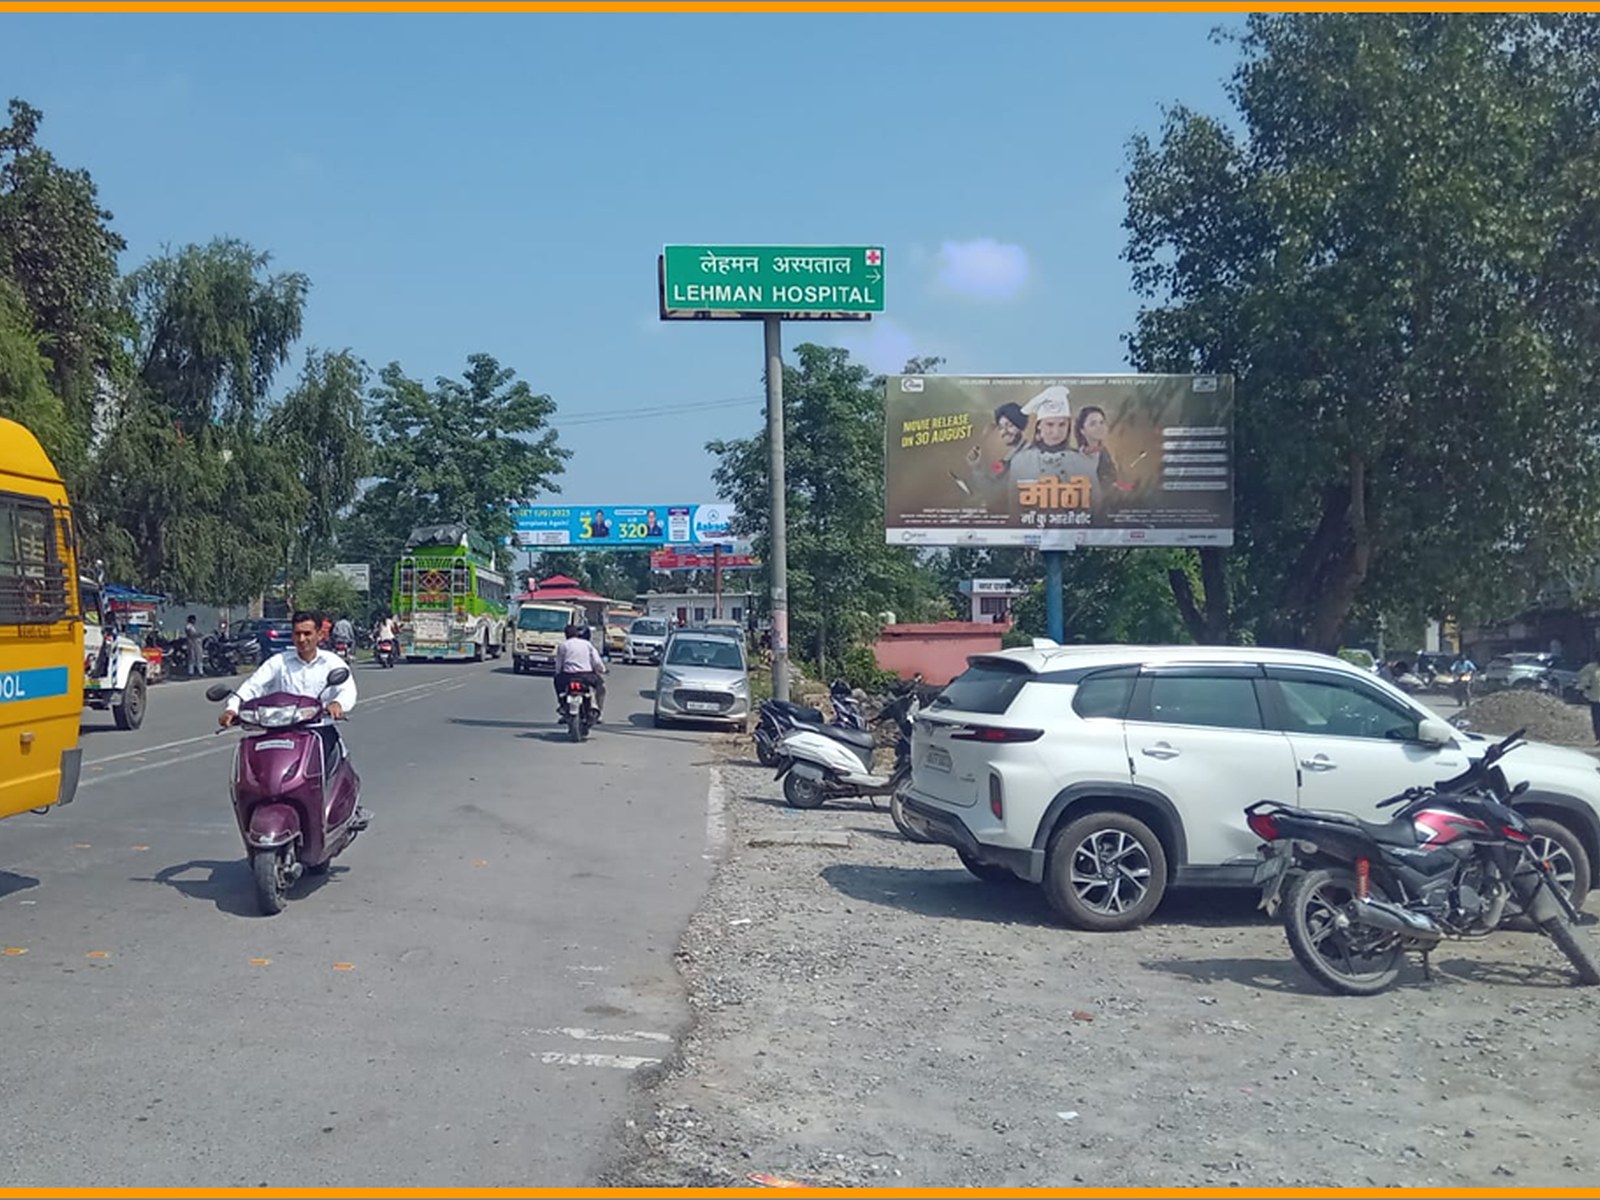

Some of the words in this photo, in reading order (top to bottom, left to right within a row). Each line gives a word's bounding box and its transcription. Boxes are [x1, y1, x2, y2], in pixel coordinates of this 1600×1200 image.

[699, 250, 759, 275] लेहमन
[772, 255, 852, 275] अस्पताल
[673, 284, 763, 303] LEHMAN
[772, 285, 876, 305] HOSPITAL
[902, 417, 930, 433] MOVIE
[931, 413, 971, 430] RELEASE
[901, 435, 914, 448] ON
[914, 431, 930, 446] 30
[931, 425, 974, 443] AUGUST
[1016, 475, 1093, 509] मीठी
[579, 516, 593, 539] 3
[618, 523, 649, 539] 320
[0, 675, 26, 699] OL
